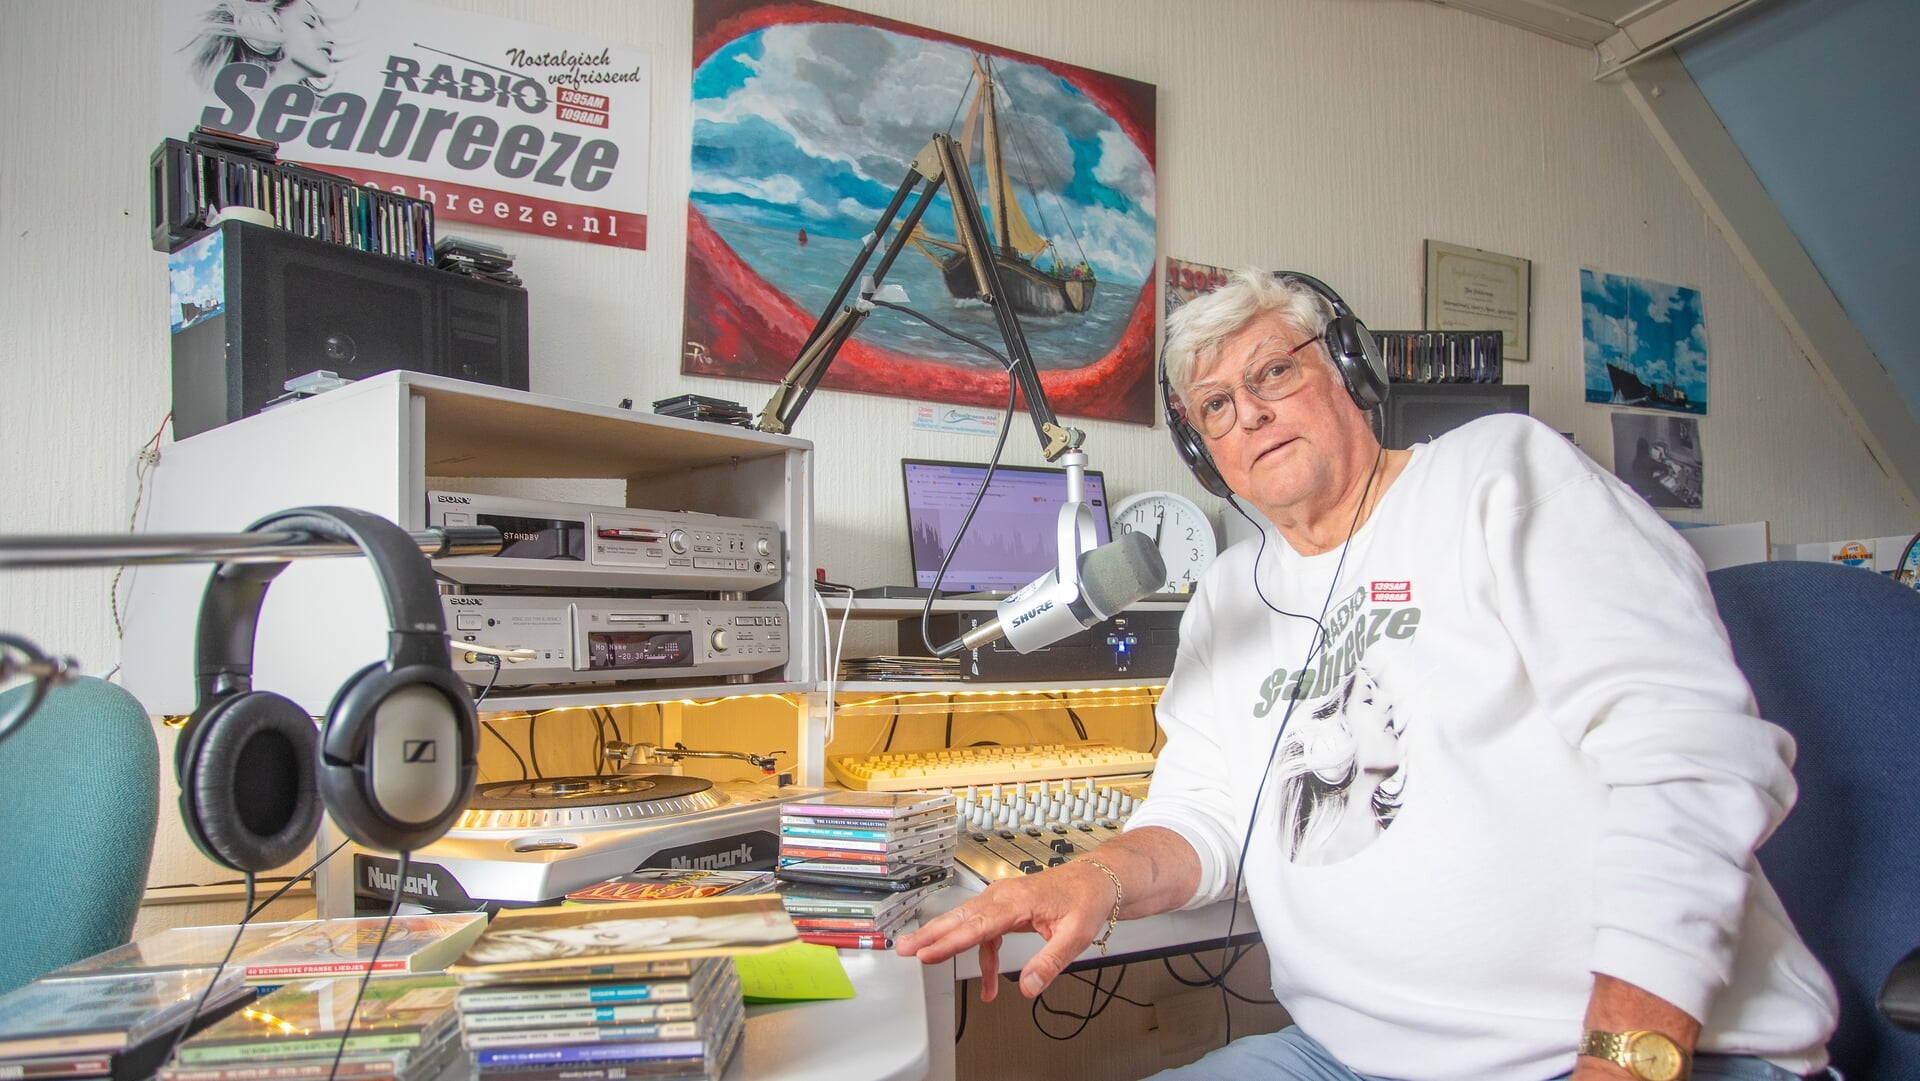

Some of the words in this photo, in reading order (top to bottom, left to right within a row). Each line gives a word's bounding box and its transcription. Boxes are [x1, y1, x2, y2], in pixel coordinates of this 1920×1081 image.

[505, 47, 611, 72] Nostalgisch
[380, 55, 553, 114] RADIO
[548, 66, 641, 90] verfrissend
[561, 90, 606, 109] 1395AM
[560, 107, 605, 126] 1098AM
[201, 62, 619, 192] Seabreeze
[438, 495, 471, 504] SONY
[1135, 510, 1144, 523] 11
[1176, 512, 1180, 525] 1
[1120, 523, 1132, 535] 10
[1186, 527, 1194, 541] 2
[503, 532, 540, 541] STANDBY
[1190, 548, 1198, 562] 3
[1183, 569, 1190, 581] 4
[1167, 581, 1176, 594] 5
[1374, 582, 1408, 591] 1395AM
[1374, 593, 1408, 602] 1098AM
[1011, 599, 1054, 628] SHURE
[259, 966, 301, 975] BEKENDSTE
[303, 965, 332, 973] FRANSE
